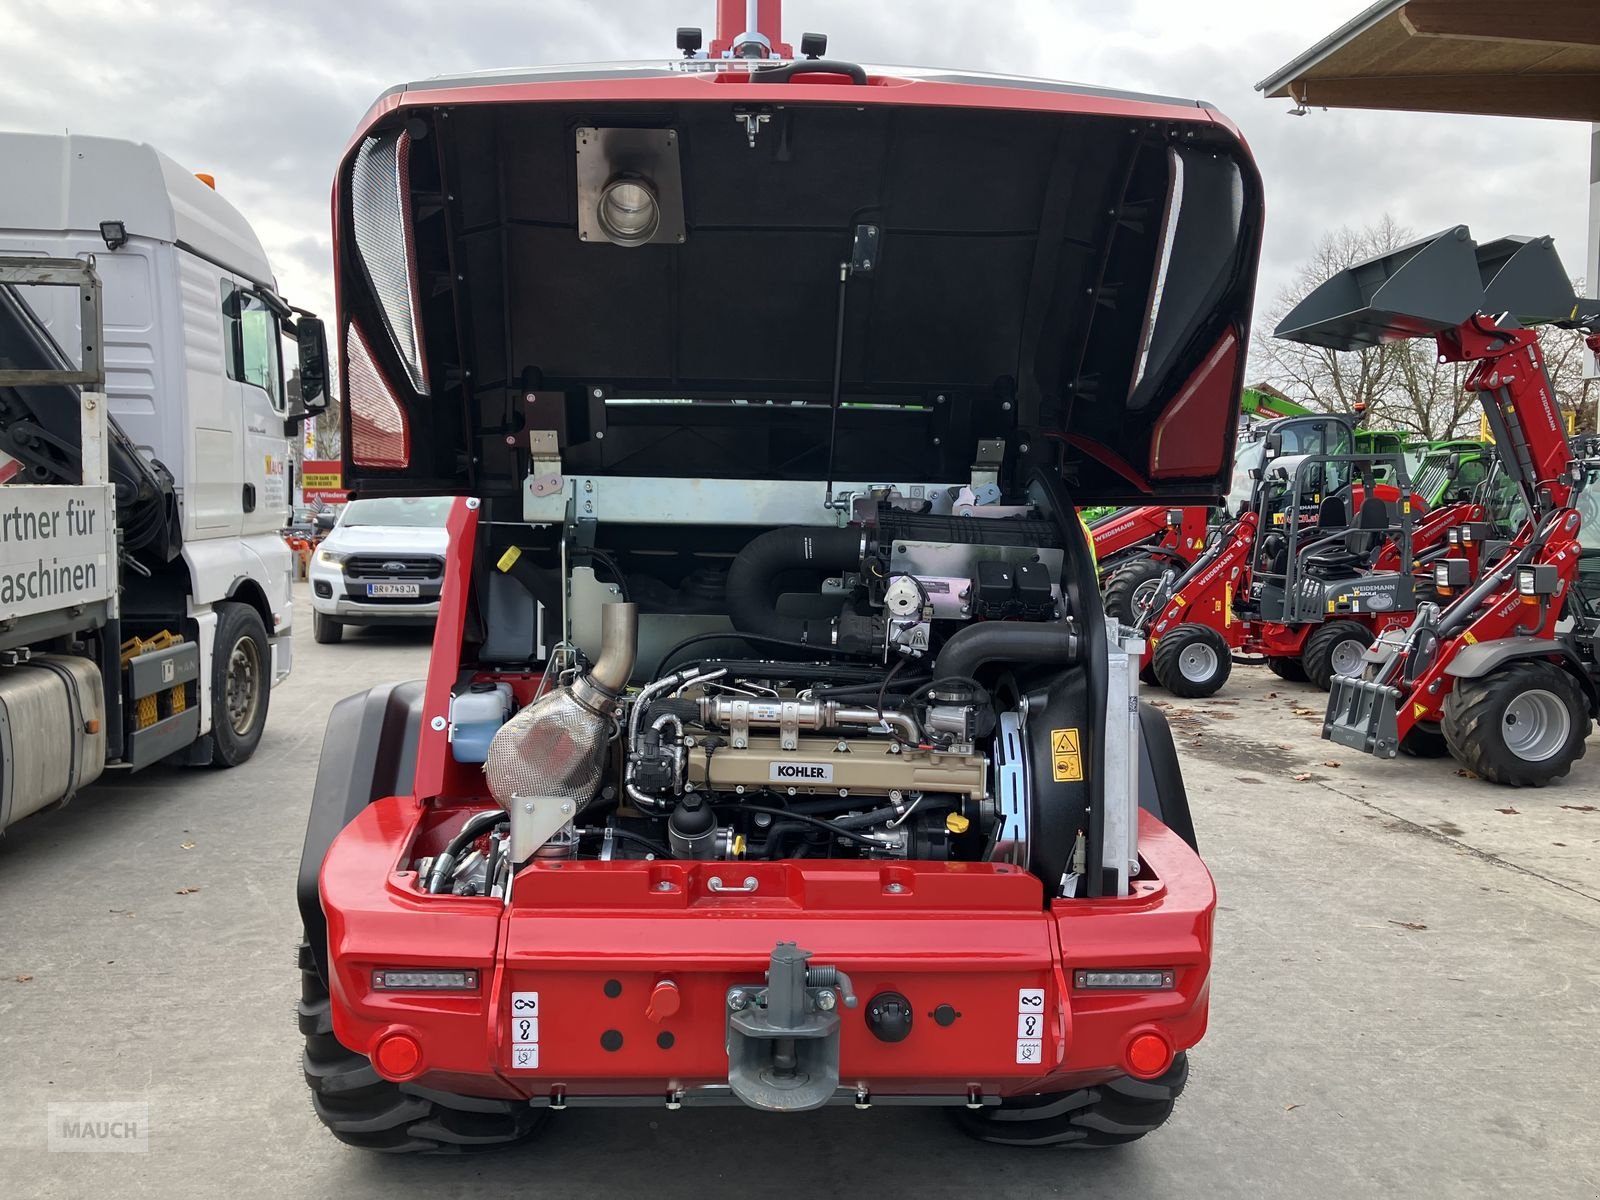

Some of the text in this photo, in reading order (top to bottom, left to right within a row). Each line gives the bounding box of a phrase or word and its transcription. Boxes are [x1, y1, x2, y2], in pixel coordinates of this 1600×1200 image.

[1539, 387, 1556, 431] WEIDEMANN
[0, 499, 96, 542] rtner für
[1094, 520, 1135, 542] WEIDEMANN
[1198, 553, 1234, 585] WEIDEMANN
[0, 557, 96, 604] aschinen
[1352, 584, 1396, 592] WEIDEMANN
[1497, 597, 1521, 617] WEID
[1387, 616, 1409, 625] 1140
[777, 765, 825, 779] KOHLER
